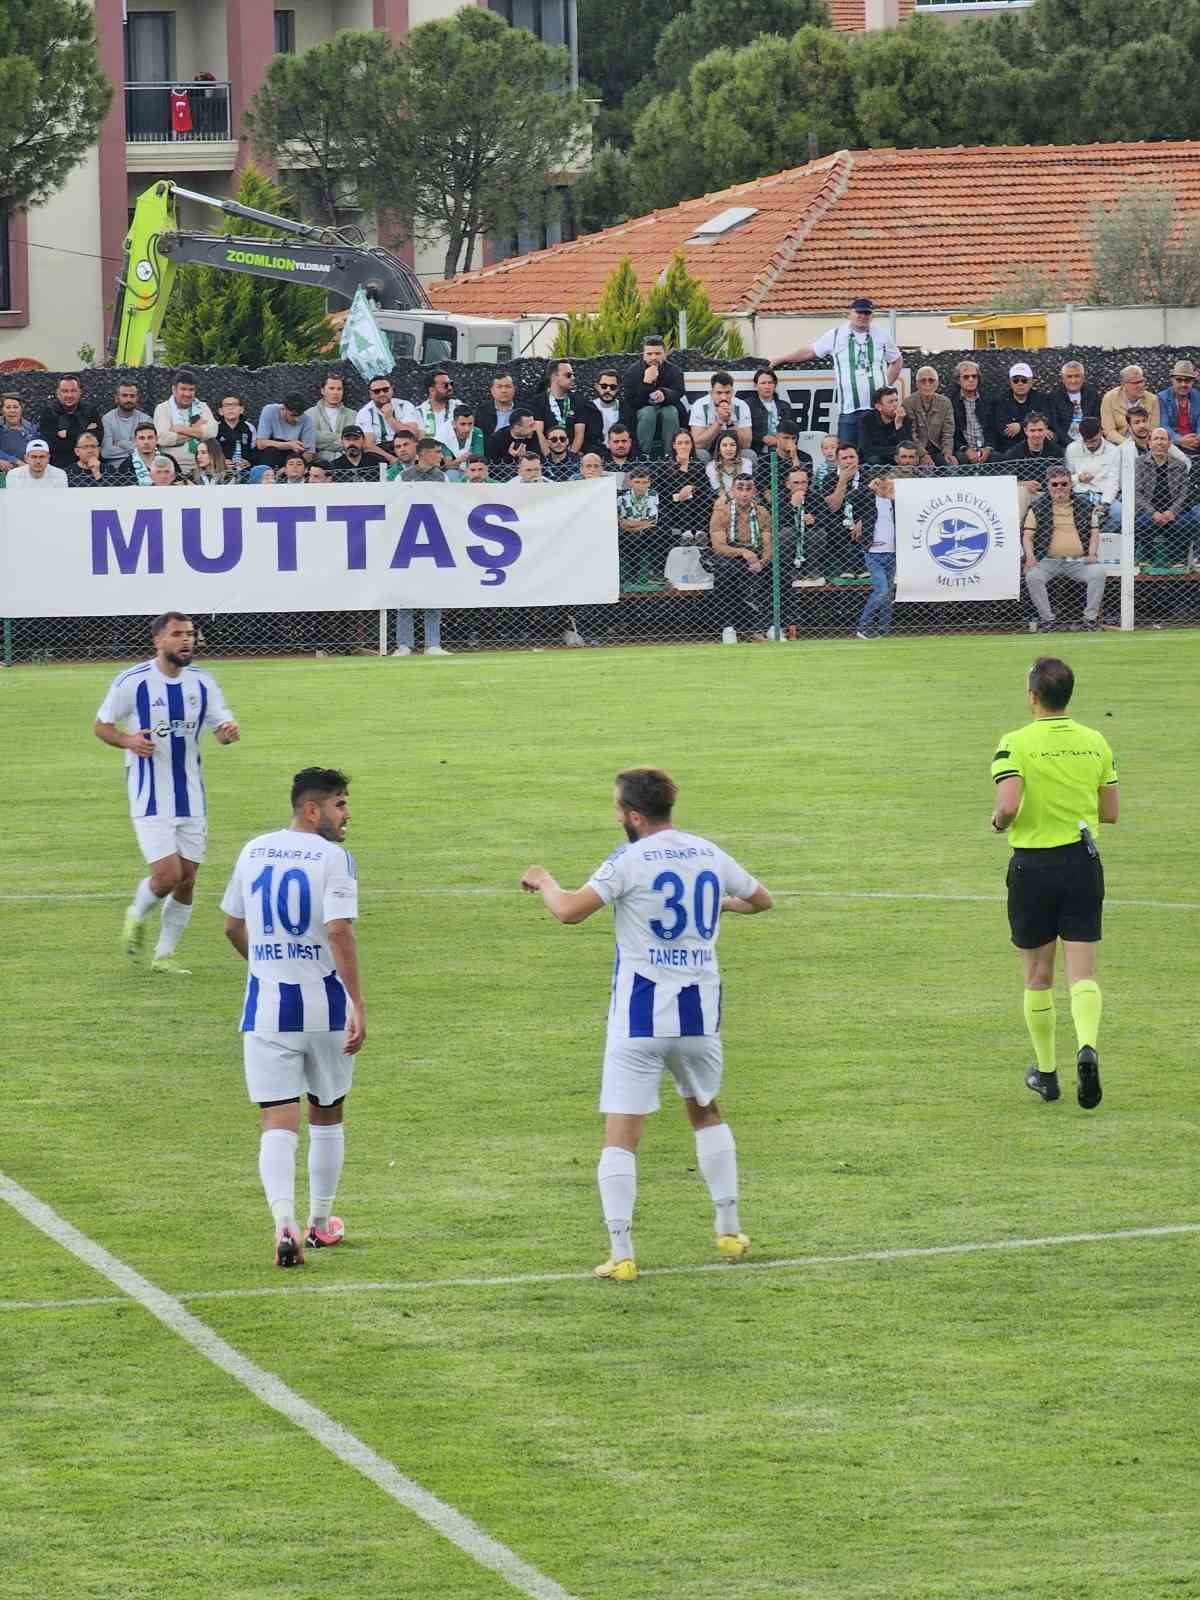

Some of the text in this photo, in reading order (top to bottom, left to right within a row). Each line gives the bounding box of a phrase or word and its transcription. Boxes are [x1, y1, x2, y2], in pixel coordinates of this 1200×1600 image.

[226, 249, 296, 272] ZOOMLION
[91, 503, 522, 586] MUTTAŞ
[250, 864, 311, 937] 10
[648, 868, 720, 941] 30
[649, 948, 688, 966] TANER
